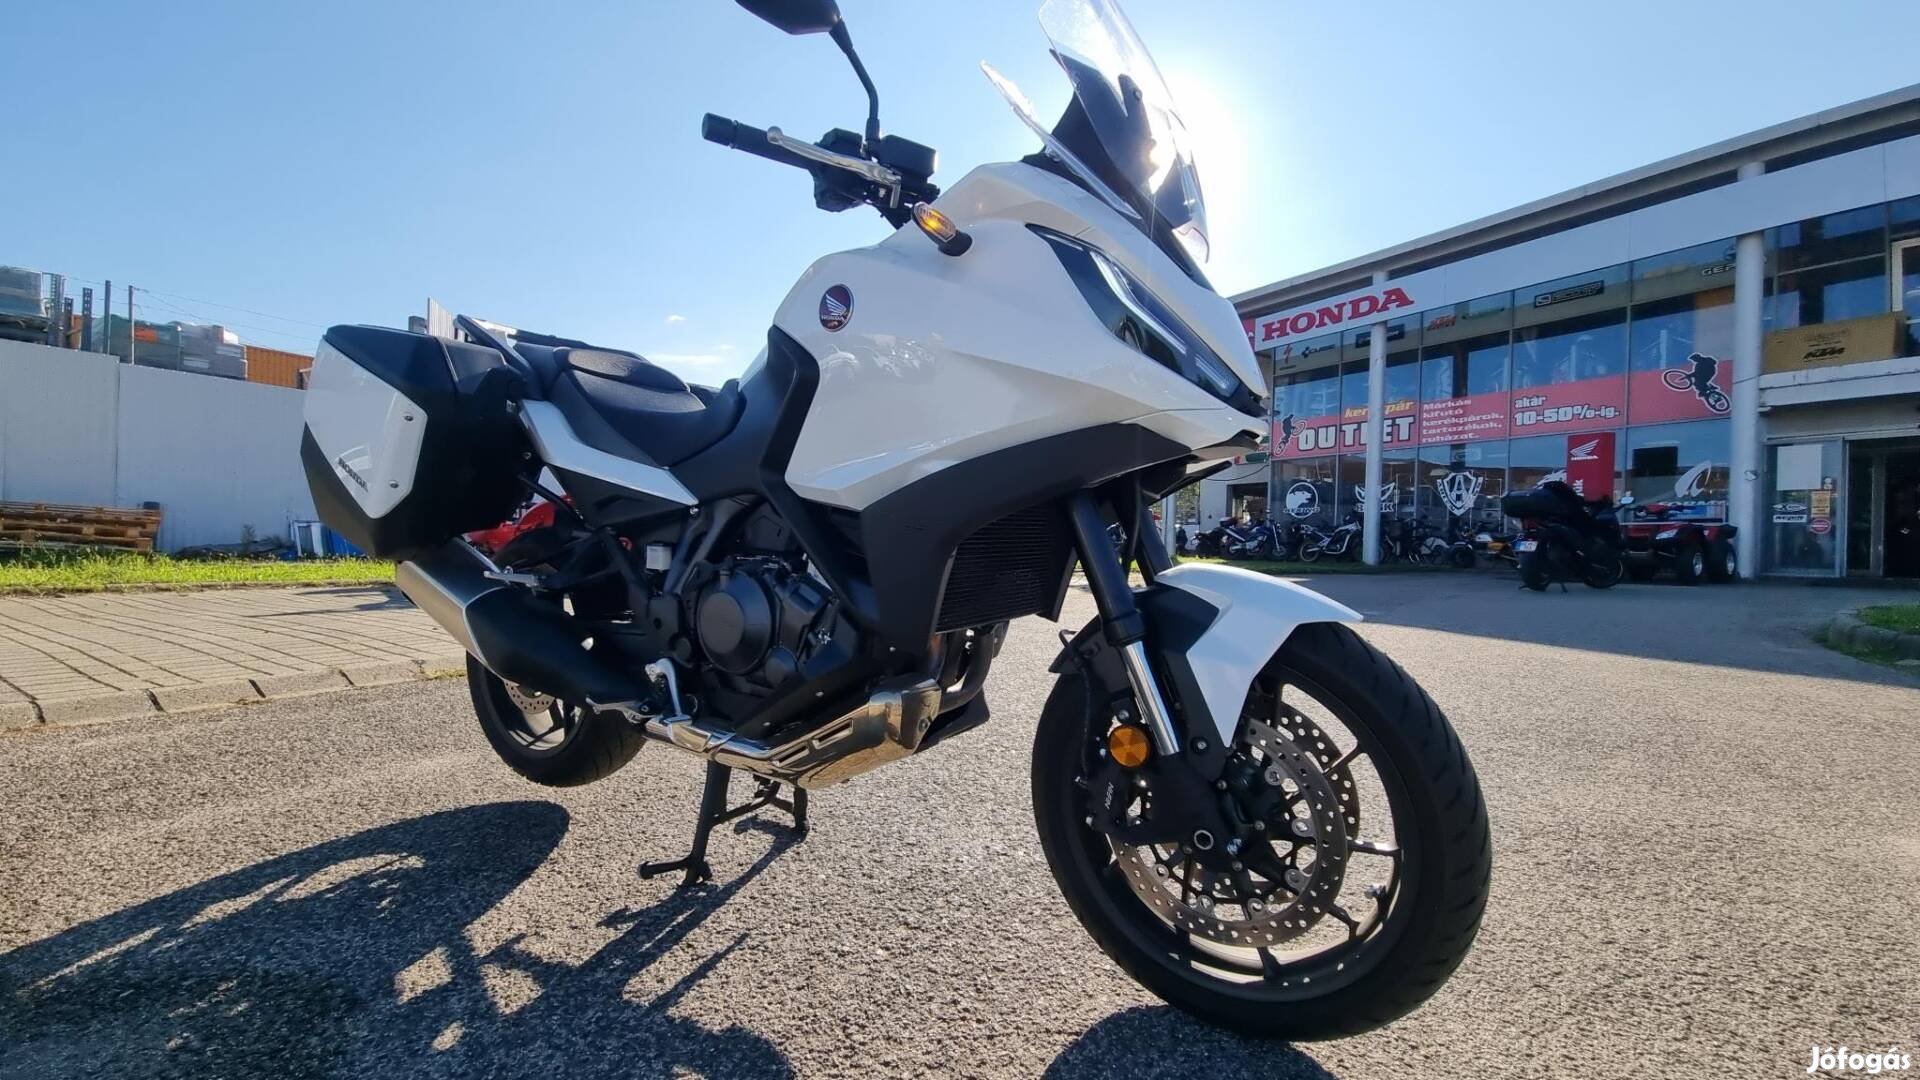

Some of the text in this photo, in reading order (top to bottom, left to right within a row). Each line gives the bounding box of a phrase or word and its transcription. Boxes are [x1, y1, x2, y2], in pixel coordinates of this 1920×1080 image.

[1262, 288, 1414, 342] HONDA
[1344, 399, 1414, 418] kerpár
[1515, 396, 1546, 408] akár
